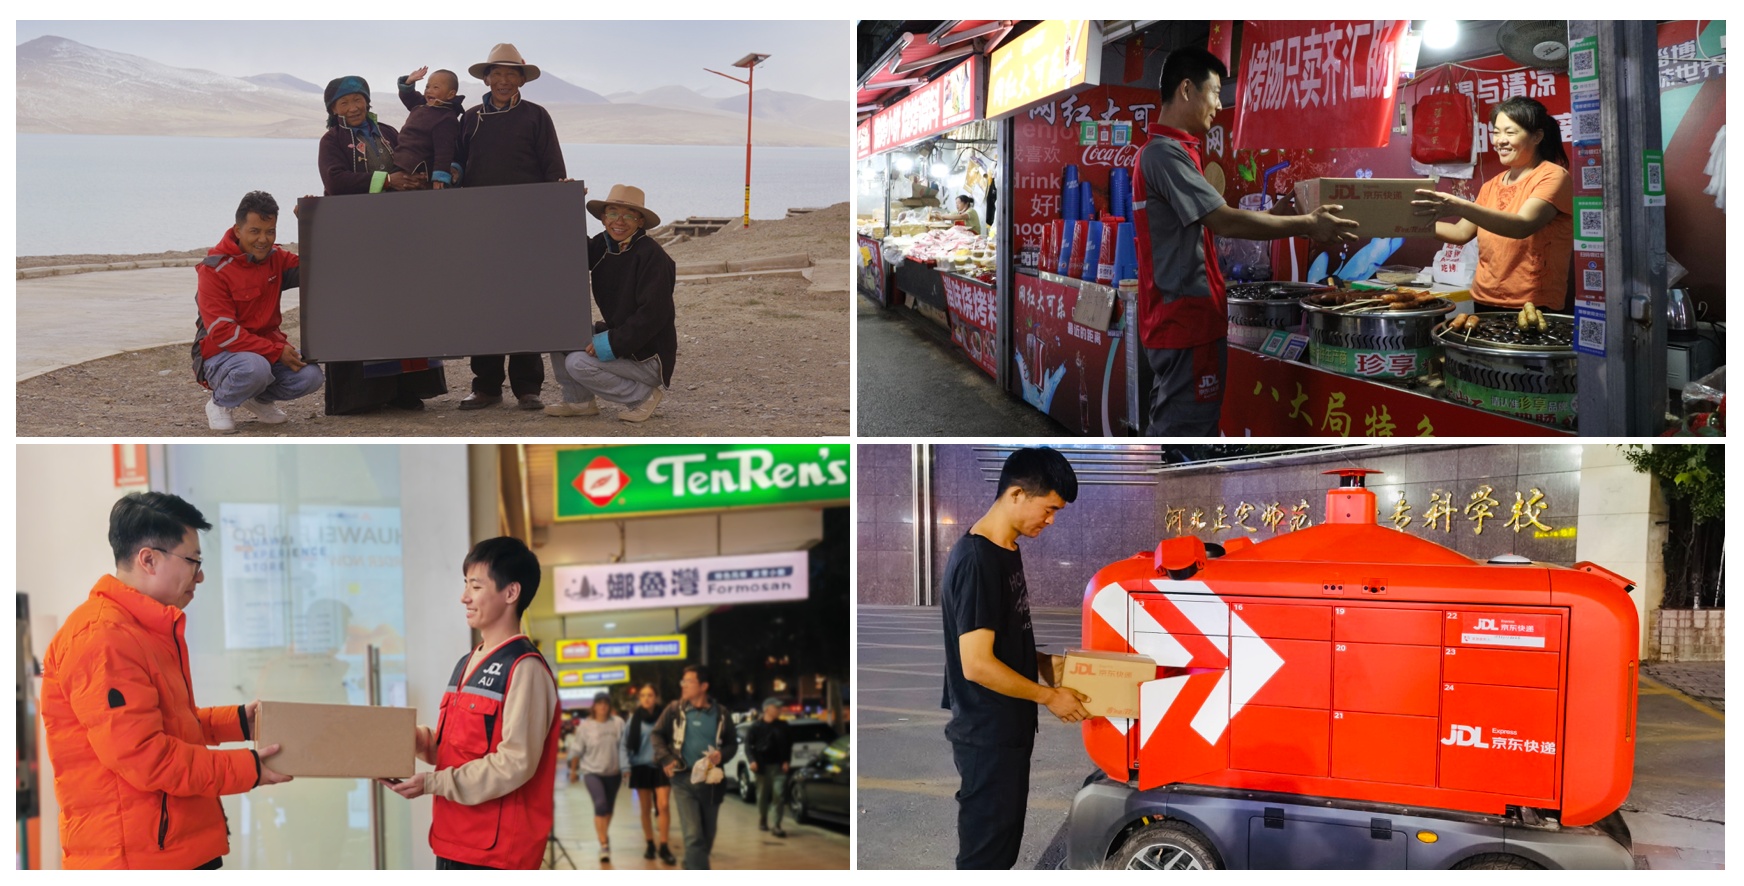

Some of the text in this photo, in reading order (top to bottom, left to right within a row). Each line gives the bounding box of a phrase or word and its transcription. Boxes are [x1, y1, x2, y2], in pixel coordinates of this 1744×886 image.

[1246, 20, 1396, 112] 烤肠只卖齐汇肠
[1082, 143, 1138, 167] Coca-Col
[1328, 185, 1360, 200] JDL
[1363, 191, 1402, 200] 京东快递
[1356, 353, 1416, 376] 珍享
[646, 449, 848, 497] TenRen's
[243, 547, 328, 560] EXPERIENCE
[243, 562, 285, 572] STORE
[707, 582, 792, 595] Formosan
[1473, 618, 1499, 631] JDL
[1501, 624, 1534, 633] 京东快递
[1336, 644, 1346, 652] 20
[483, 662, 503, 676] JDL
[1070, 663, 1096, 676] JDL
[1100, 668, 1133, 679] 京东快递
[478, 676, 494, 687] AU
[1440, 724, 1489, 749] JDL
[1492, 737, 1556, 755] 京东快递
